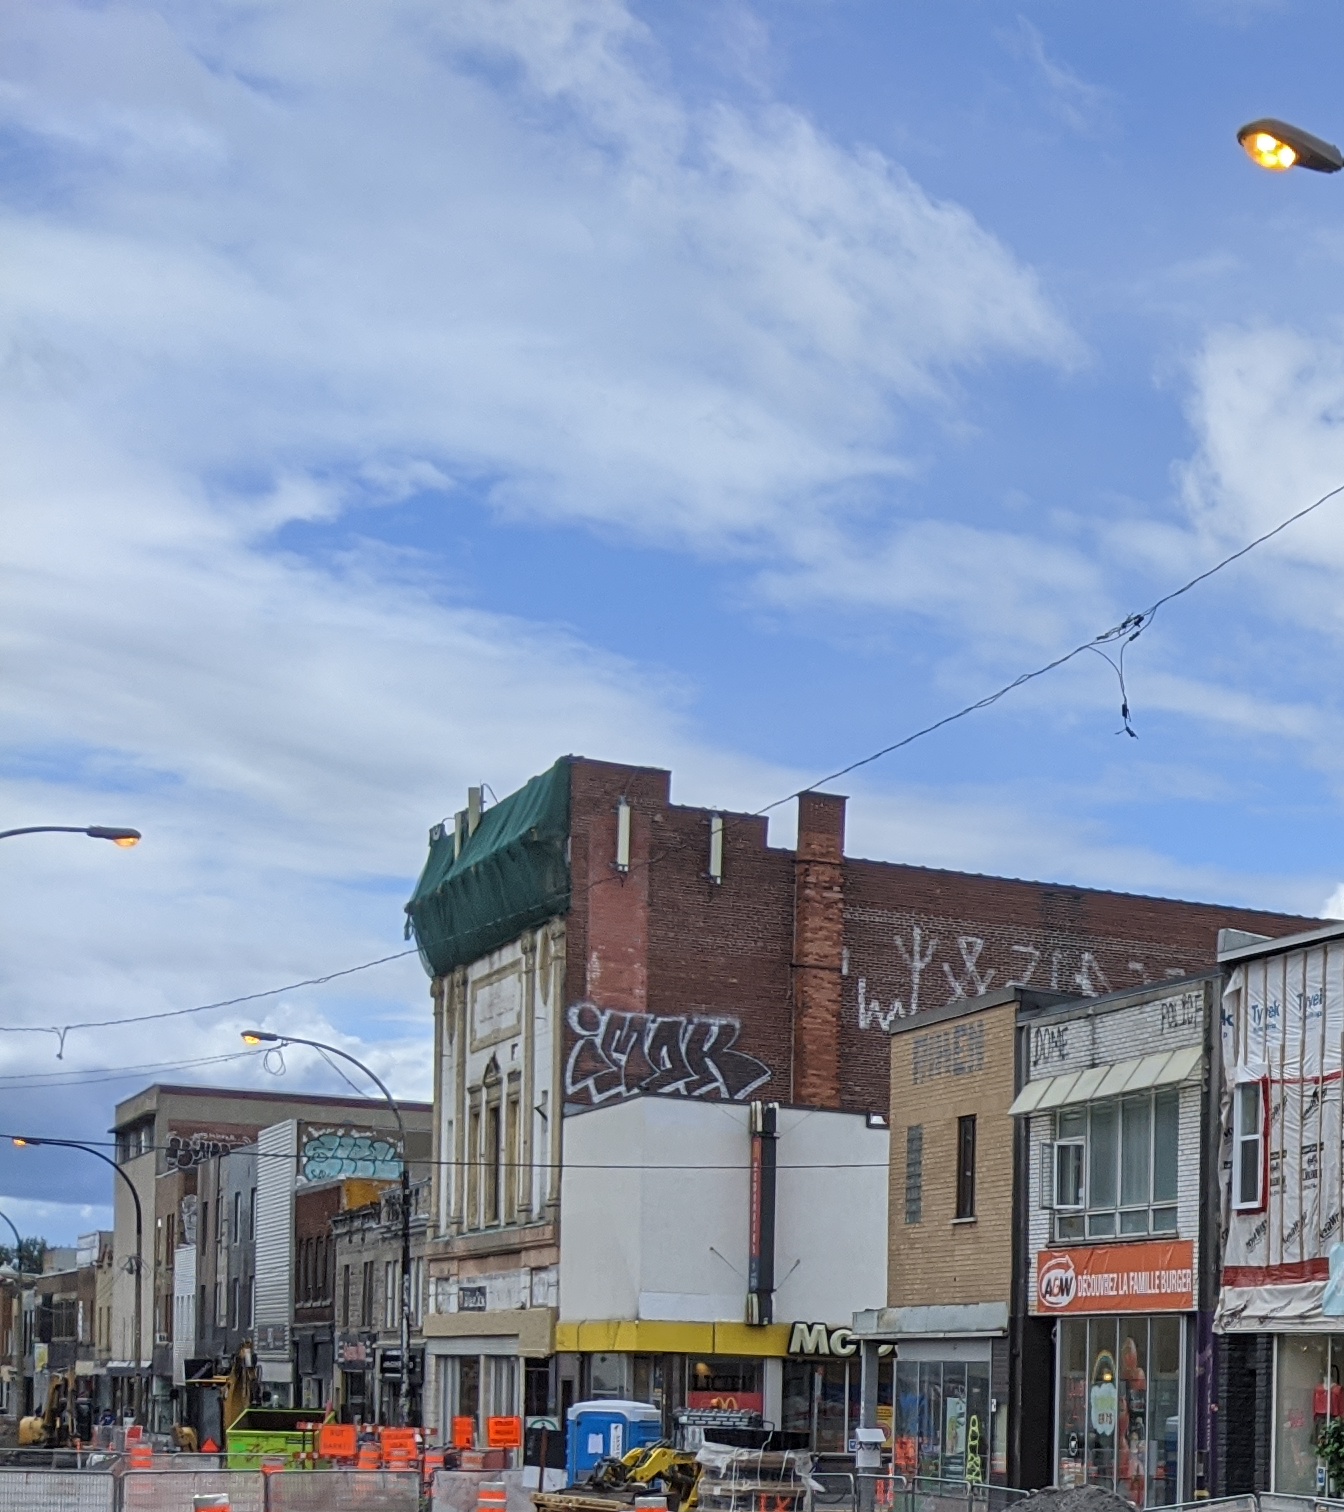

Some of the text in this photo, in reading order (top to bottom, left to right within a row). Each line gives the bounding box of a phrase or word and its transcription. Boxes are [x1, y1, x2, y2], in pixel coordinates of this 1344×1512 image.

[1044, 1269, 1191, 1298] A&W DÉCOUVREZ LA FAMILLE BURGER
